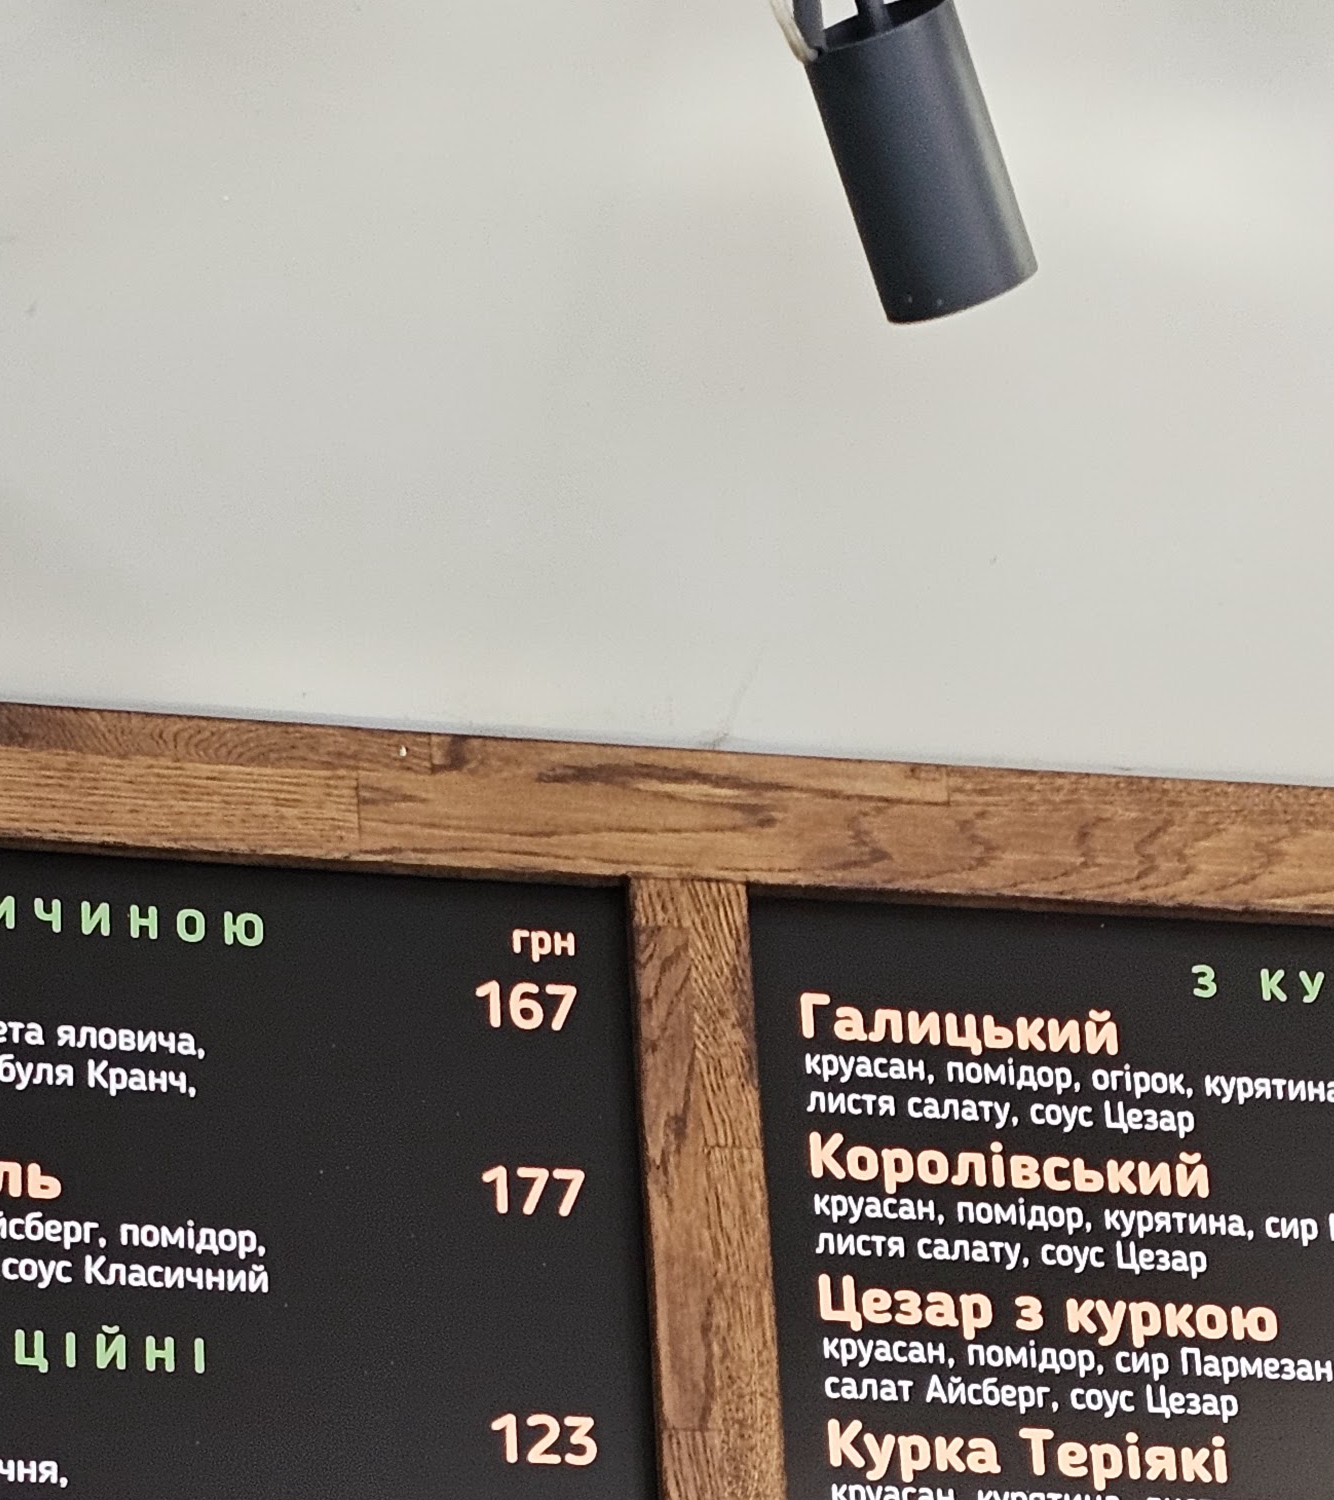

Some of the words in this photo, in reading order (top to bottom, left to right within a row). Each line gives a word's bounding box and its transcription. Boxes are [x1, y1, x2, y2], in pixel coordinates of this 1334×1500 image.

[510, 927, 577, 964] грн
[474, 978, 579, 1033] 167
[1190, 963, 1218, 999] З
[798, 990, 1120, 1058] Галицький
[480, 1163, 587, 1218] 177
[807, 1129, 1211, 1200] Королівський
[0, 1256, 74, 1290] соус
[83, 1253, 270, 1295] Класичний
[816, 1272, 995, 1342] Цезар
[1013, 1294, 1045, 1333] з
[1064, 1296, 1279, 1350] куркою
[821, 1335, 956, 1370] круасан,
[966, 1338, 1105, 1380] помідор,
[1114, 1349, 1171, 1383] сир
[489, 1411, 599, 1467] 123
[826, 1417, 1003, 1485] Курка
[1017, 1426, 1230, 1493] Теріякі
